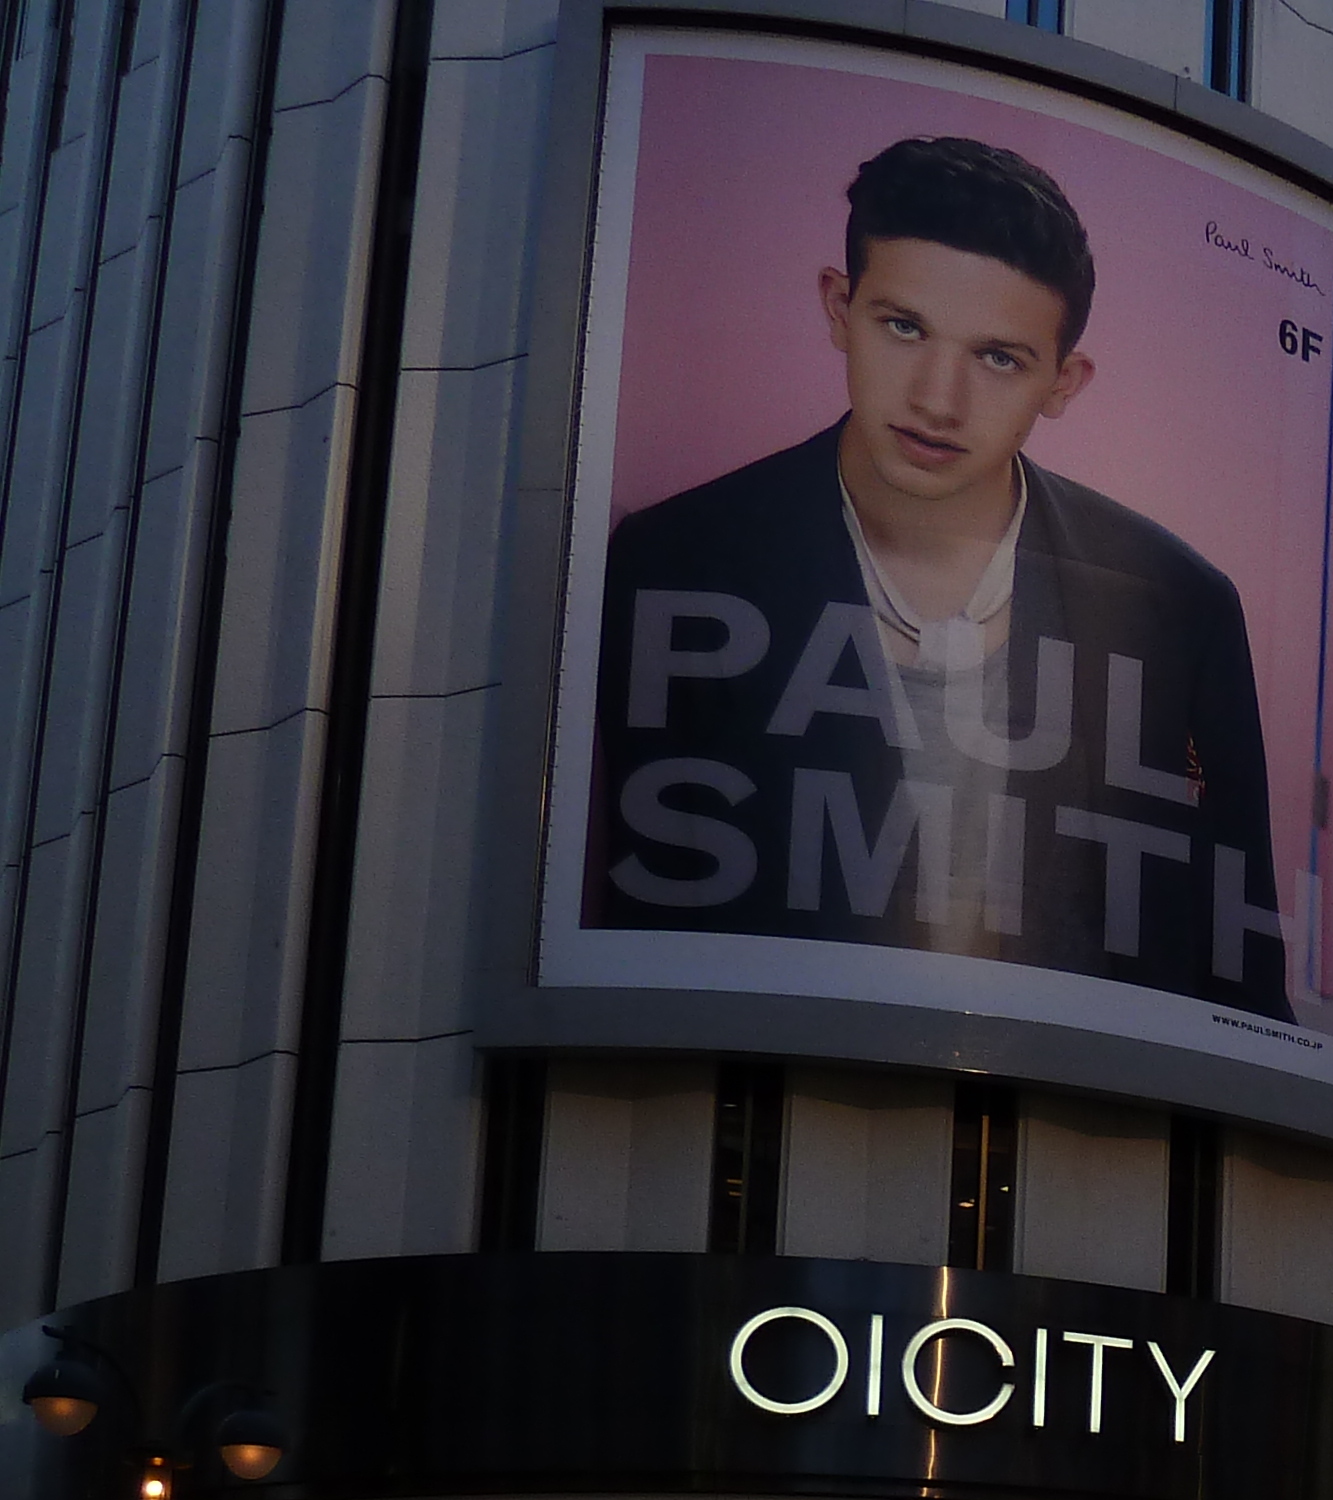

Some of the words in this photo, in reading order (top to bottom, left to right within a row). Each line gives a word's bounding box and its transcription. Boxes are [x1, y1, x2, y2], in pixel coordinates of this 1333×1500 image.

[1205, 221, 1254, 264] Paul
[1262, 243, 1326, 297] Smith
[1278, 319, 1324, 364] 6F
[627, 588, 1203, 810] PAUL
[608, 756, 1324, 1006] SMITH
[1211, 1013, 1324, 1050] WWW.PAULSMITH.CO.JP
[729, 1305, 1217, 1445] OICITY
